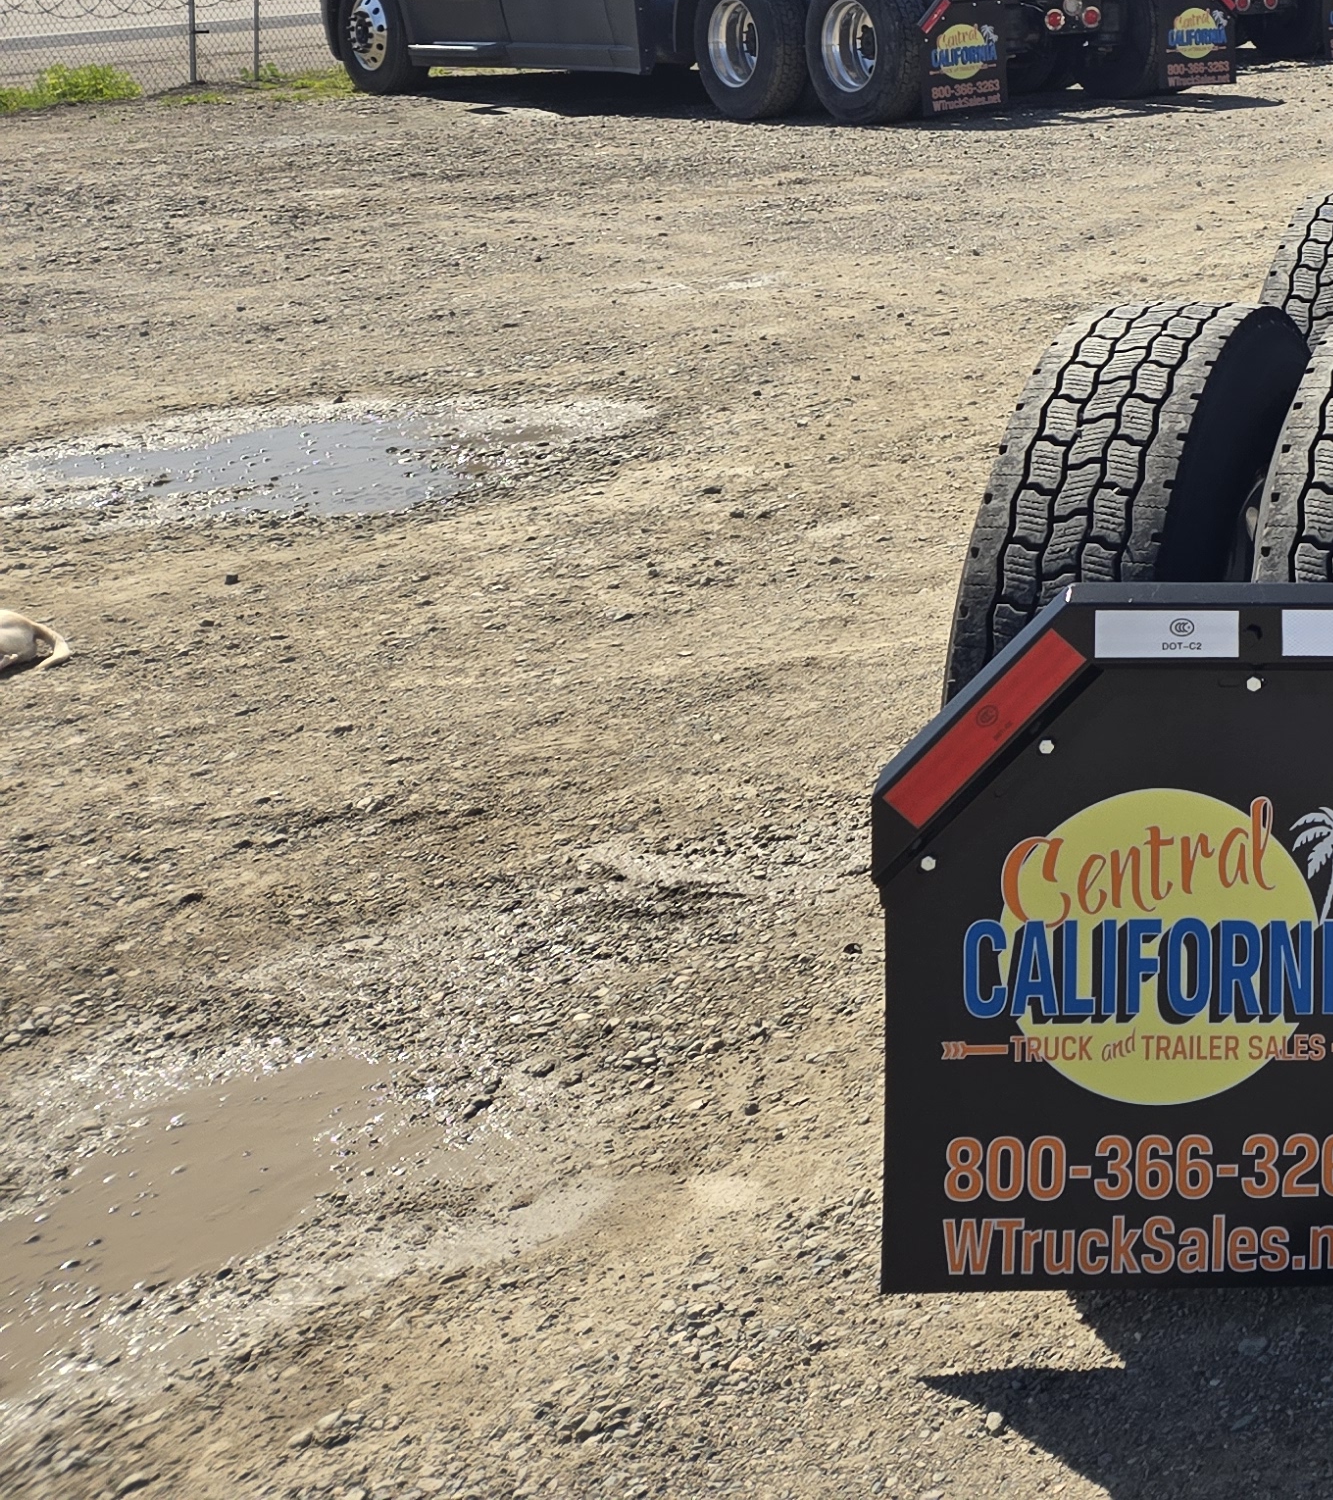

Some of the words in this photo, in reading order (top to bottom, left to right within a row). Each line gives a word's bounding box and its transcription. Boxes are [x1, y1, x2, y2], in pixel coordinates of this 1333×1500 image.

[1168, 26, 1227, 46] CALIFORNIA
[931, 41, 997, 68] CALIFORNIA
[931, 79, 1000, 99] 800-366-3263
[1161, 641, 1203, 651] DOT-C2
[1002, 795, 1276, 929] Central
[1009, 1033, 1094, 1063] TRUCK
[1100, 1027, 1137, 1063] and
[1140, 1033, 1241, 1062] TRAILER
[1247, 1033, 1327, 1062] SALES
